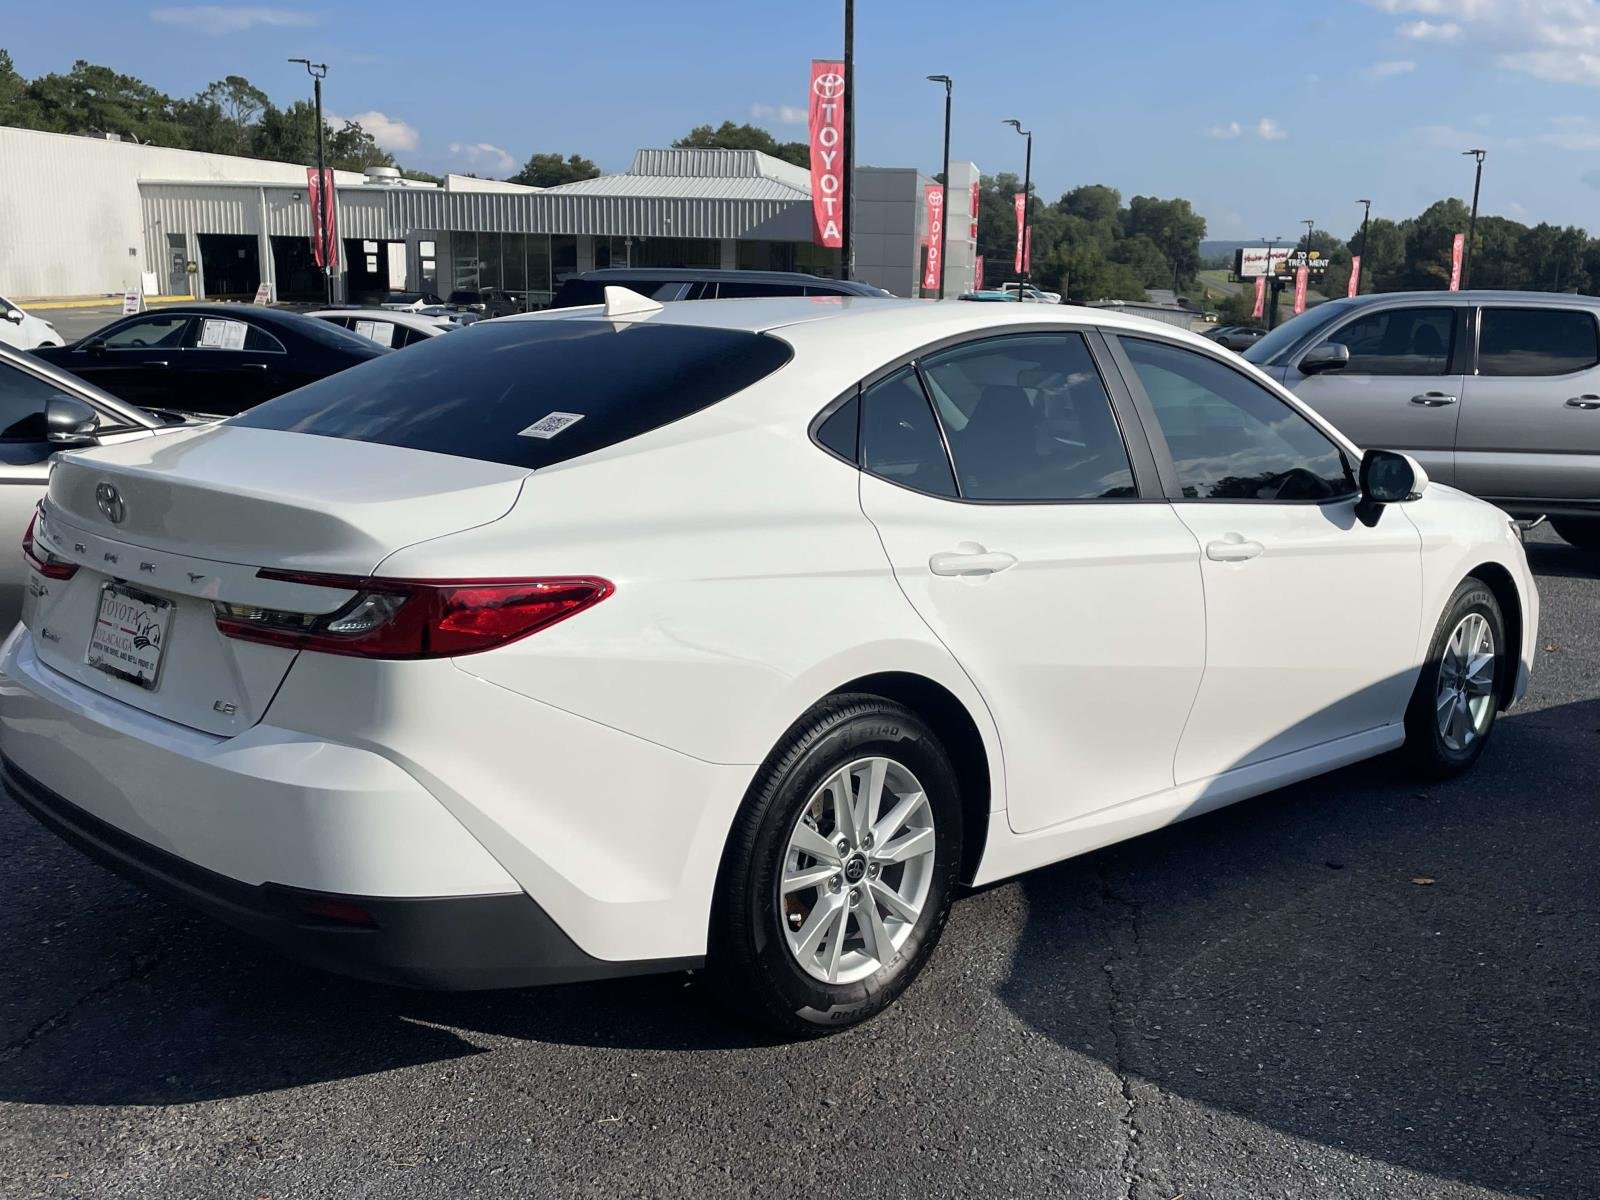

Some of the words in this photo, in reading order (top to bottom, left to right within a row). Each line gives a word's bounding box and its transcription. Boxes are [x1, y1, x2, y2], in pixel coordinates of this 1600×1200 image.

[819, 103, 840, 239] TOYOTA
[925, 208, 942, 285] TOYOTA
[1297, 251, 1307, 259] TO
[1288, 258, 1330, 267] TREAMENT
[101, 598, 139, 625] TOYOTA
[213, 700, 237, 716] LE
